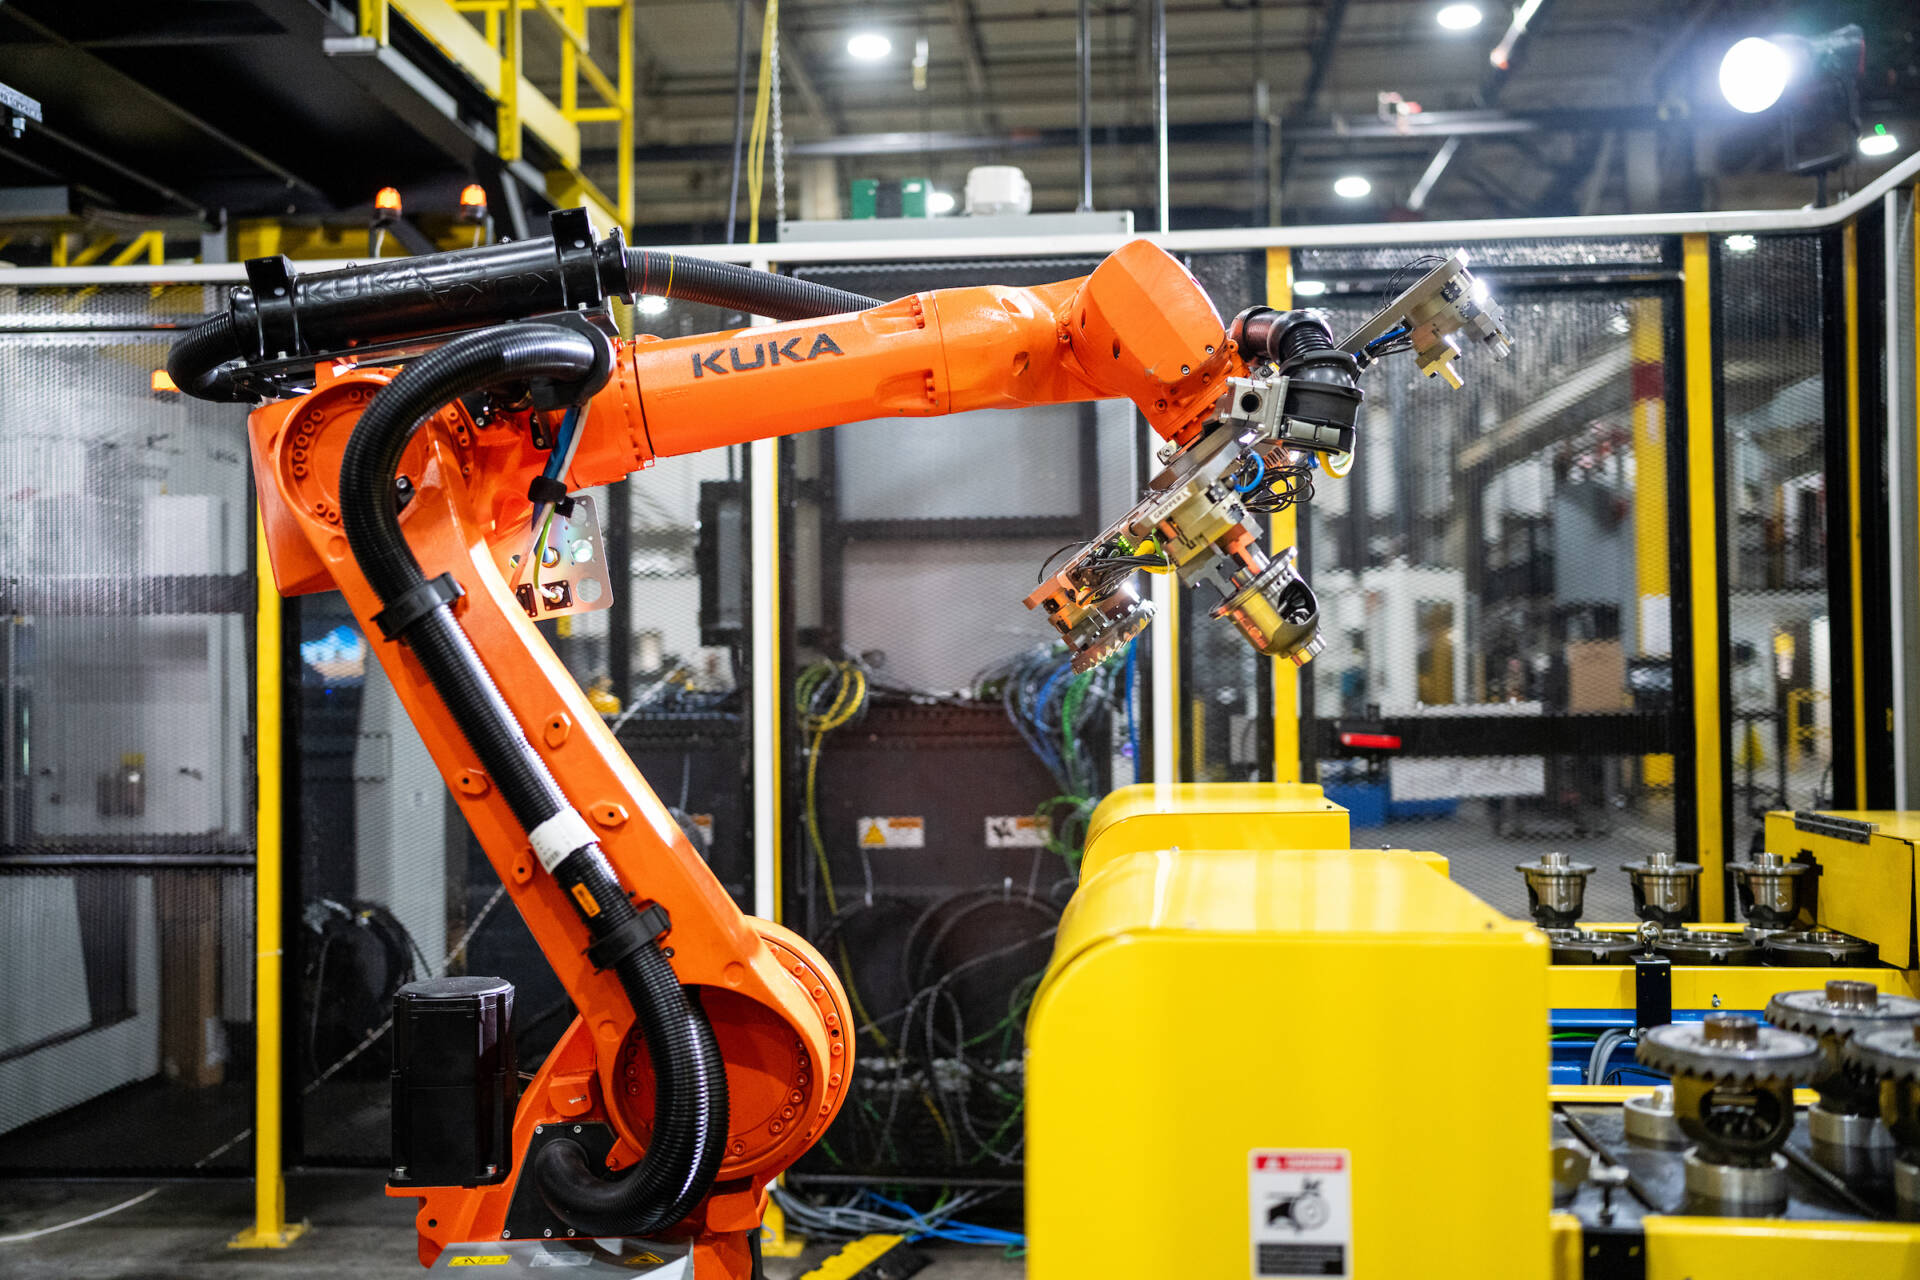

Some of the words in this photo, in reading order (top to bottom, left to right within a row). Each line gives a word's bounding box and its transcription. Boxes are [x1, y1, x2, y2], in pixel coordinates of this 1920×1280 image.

[297, 267, 432, 304] KUKA
[691, 332, 844, 378] KUKA
[1153, 494, 1182, 518] GRIPPER
